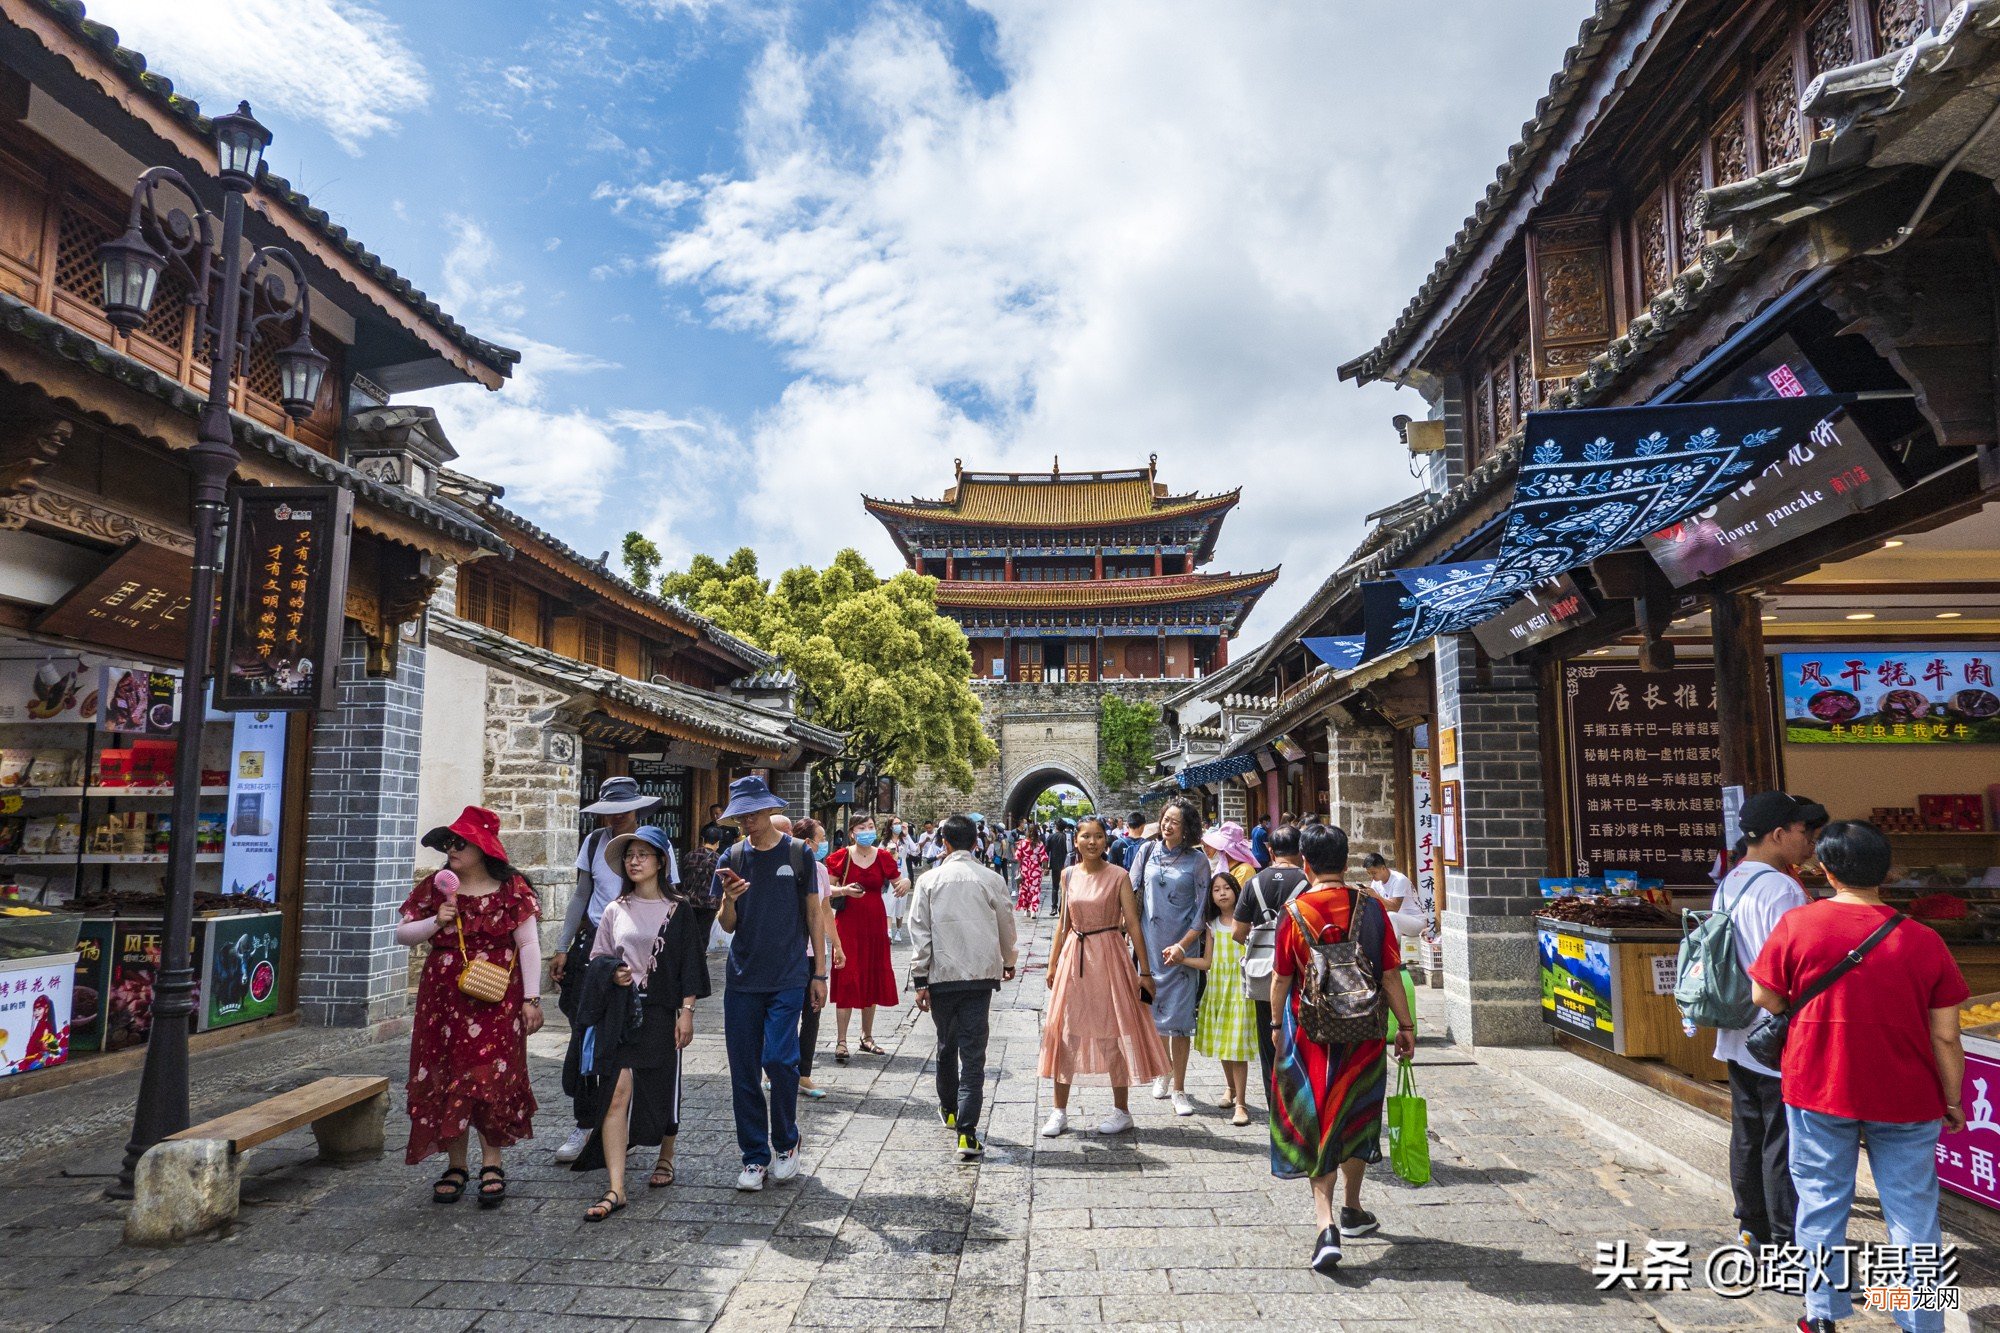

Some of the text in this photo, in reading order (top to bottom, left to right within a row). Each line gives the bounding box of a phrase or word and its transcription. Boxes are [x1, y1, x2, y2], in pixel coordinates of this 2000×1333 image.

[1714, 490, 1824, 546] Flower pancake
[100, 581, 191, 620] 潘祥记
[256, 544, 284, 658] 才有文明的城市
[287, 530, 311, 644] 只有文明的市民
[88, 609, 107, 618] Pan
[1509, 613, 1550, 639] YAK MEAT
[1800, 658, 1993, 691] 风干牦牛肉
[1832, 724, 1968, 738] 牛吃虫草我吃牛
[1936, 1143, 1997, 1191] 手工 再
